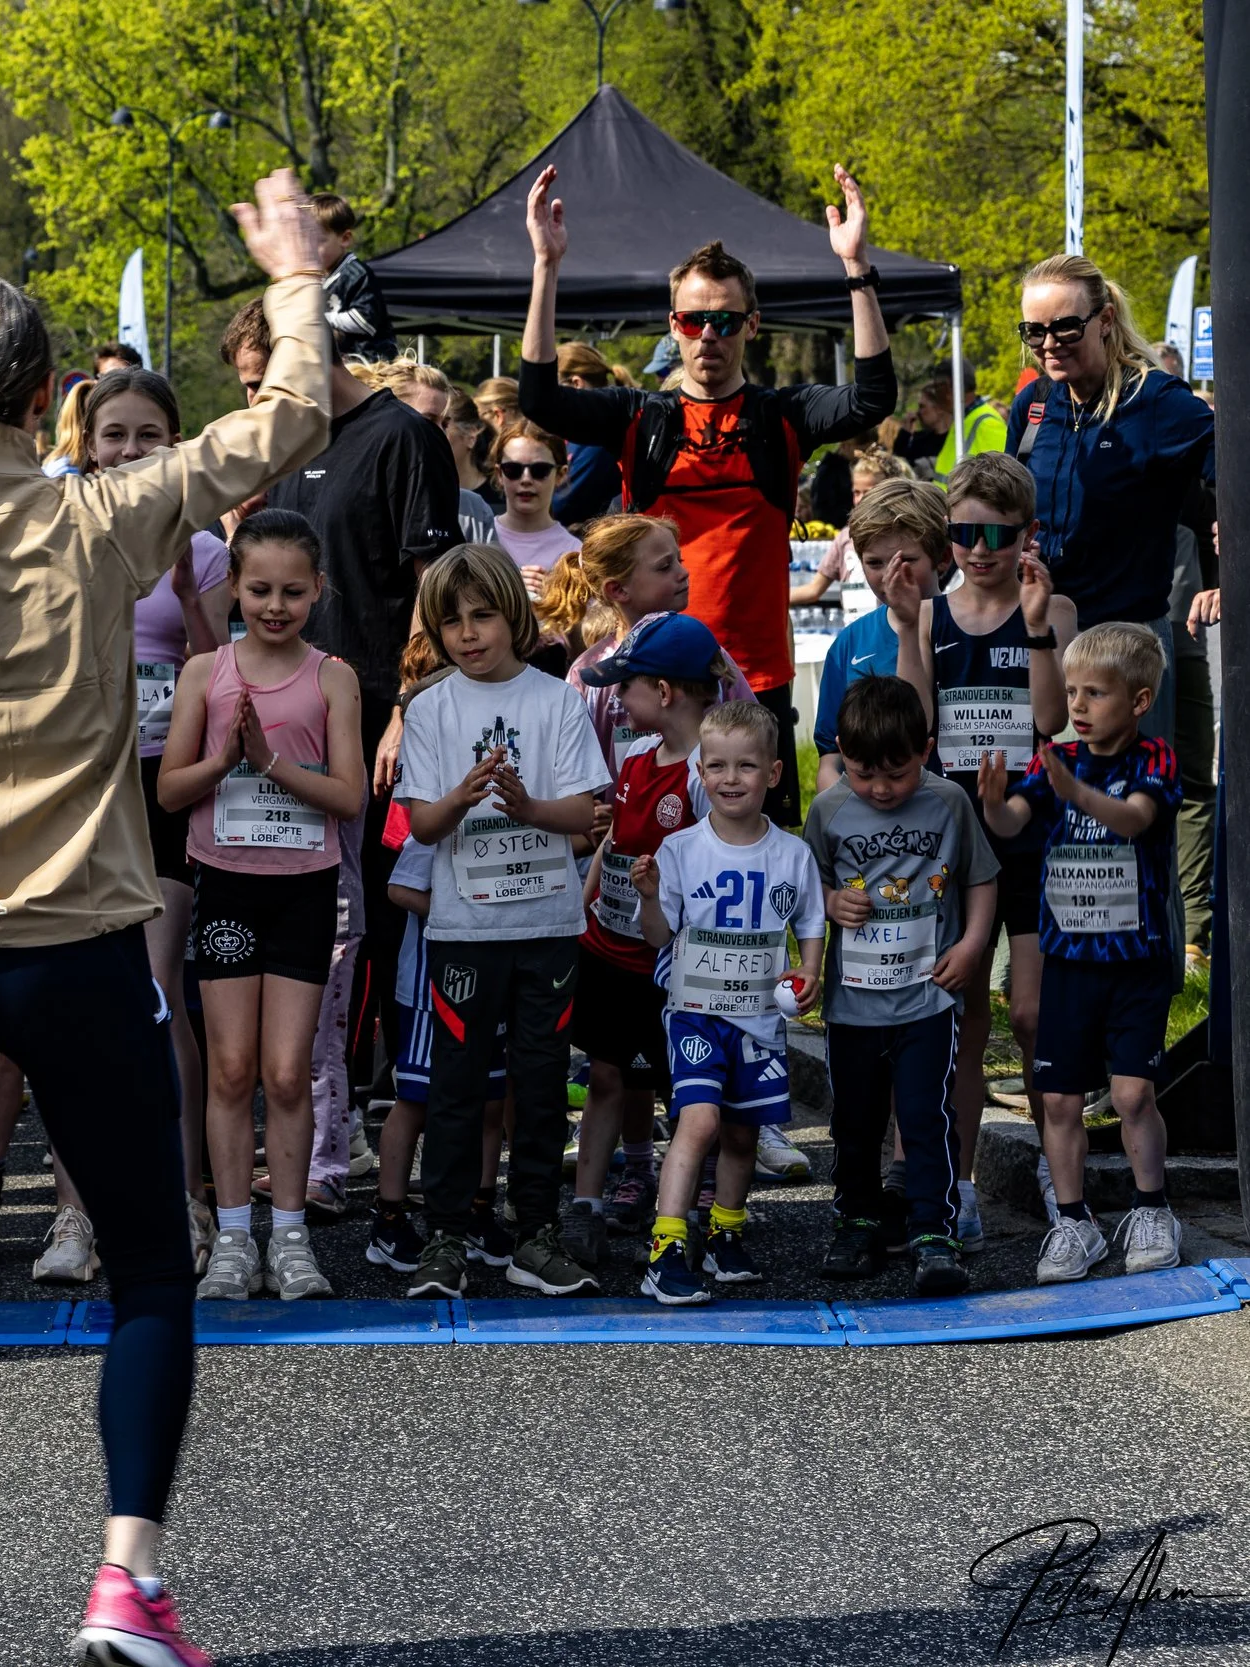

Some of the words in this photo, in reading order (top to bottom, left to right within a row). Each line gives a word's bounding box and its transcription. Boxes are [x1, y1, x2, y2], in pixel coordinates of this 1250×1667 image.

[944, 689, 999, 702] STRANDVEJEN
[1002, 690, 1013, 700] 5K
[954, 709, 1012, 720] WILLIAM
[939, 722, 972, 731] ENSHELM
[974, 721, 1033, 731] SPANGGAARD
[970, 734, 995, 746] 129
[251, 795, 304, 807] VERGMANN
[265, 810, 290, 822] 218
[251, 824, 302, 835] GENTOFTE
[251, 833, 302, 845] LØBEKLUB
[506, 862, 531, 876] 587
[1050, 867, 1124, 879] ALEXANDER
[494, 876, 544, 889] GENTOFTE
[495, 884, 545, 898] LØBEKLUB
[715, 870, 765, 929] 21
[1072, 895, 1096, 907] 130
[912, 906, 921, 917] 5K
[1061, 910, 1110, 919] GENTOFTE
[203, 919, 256, 943] KONGELIGE
[854, 926, 908, 944] AXEL
[697, 930, 757, 945] STRANDVEJEN
[758, 933, 769, 944] 5K
[215, 946, 255, 964] TEATER
[880, 953, 905, 965] 576
[696, 950, 773, 975] ALFRED
[867, 966, 913, 977] GENTOFTE
[723, 980, 749, 991] 556
[867, 974, 913, 985] LØBEKLUB
[709, 994, 760, 1004] GENTOFTE
[709, 1002, 760, 1012] LØBEKLUB
